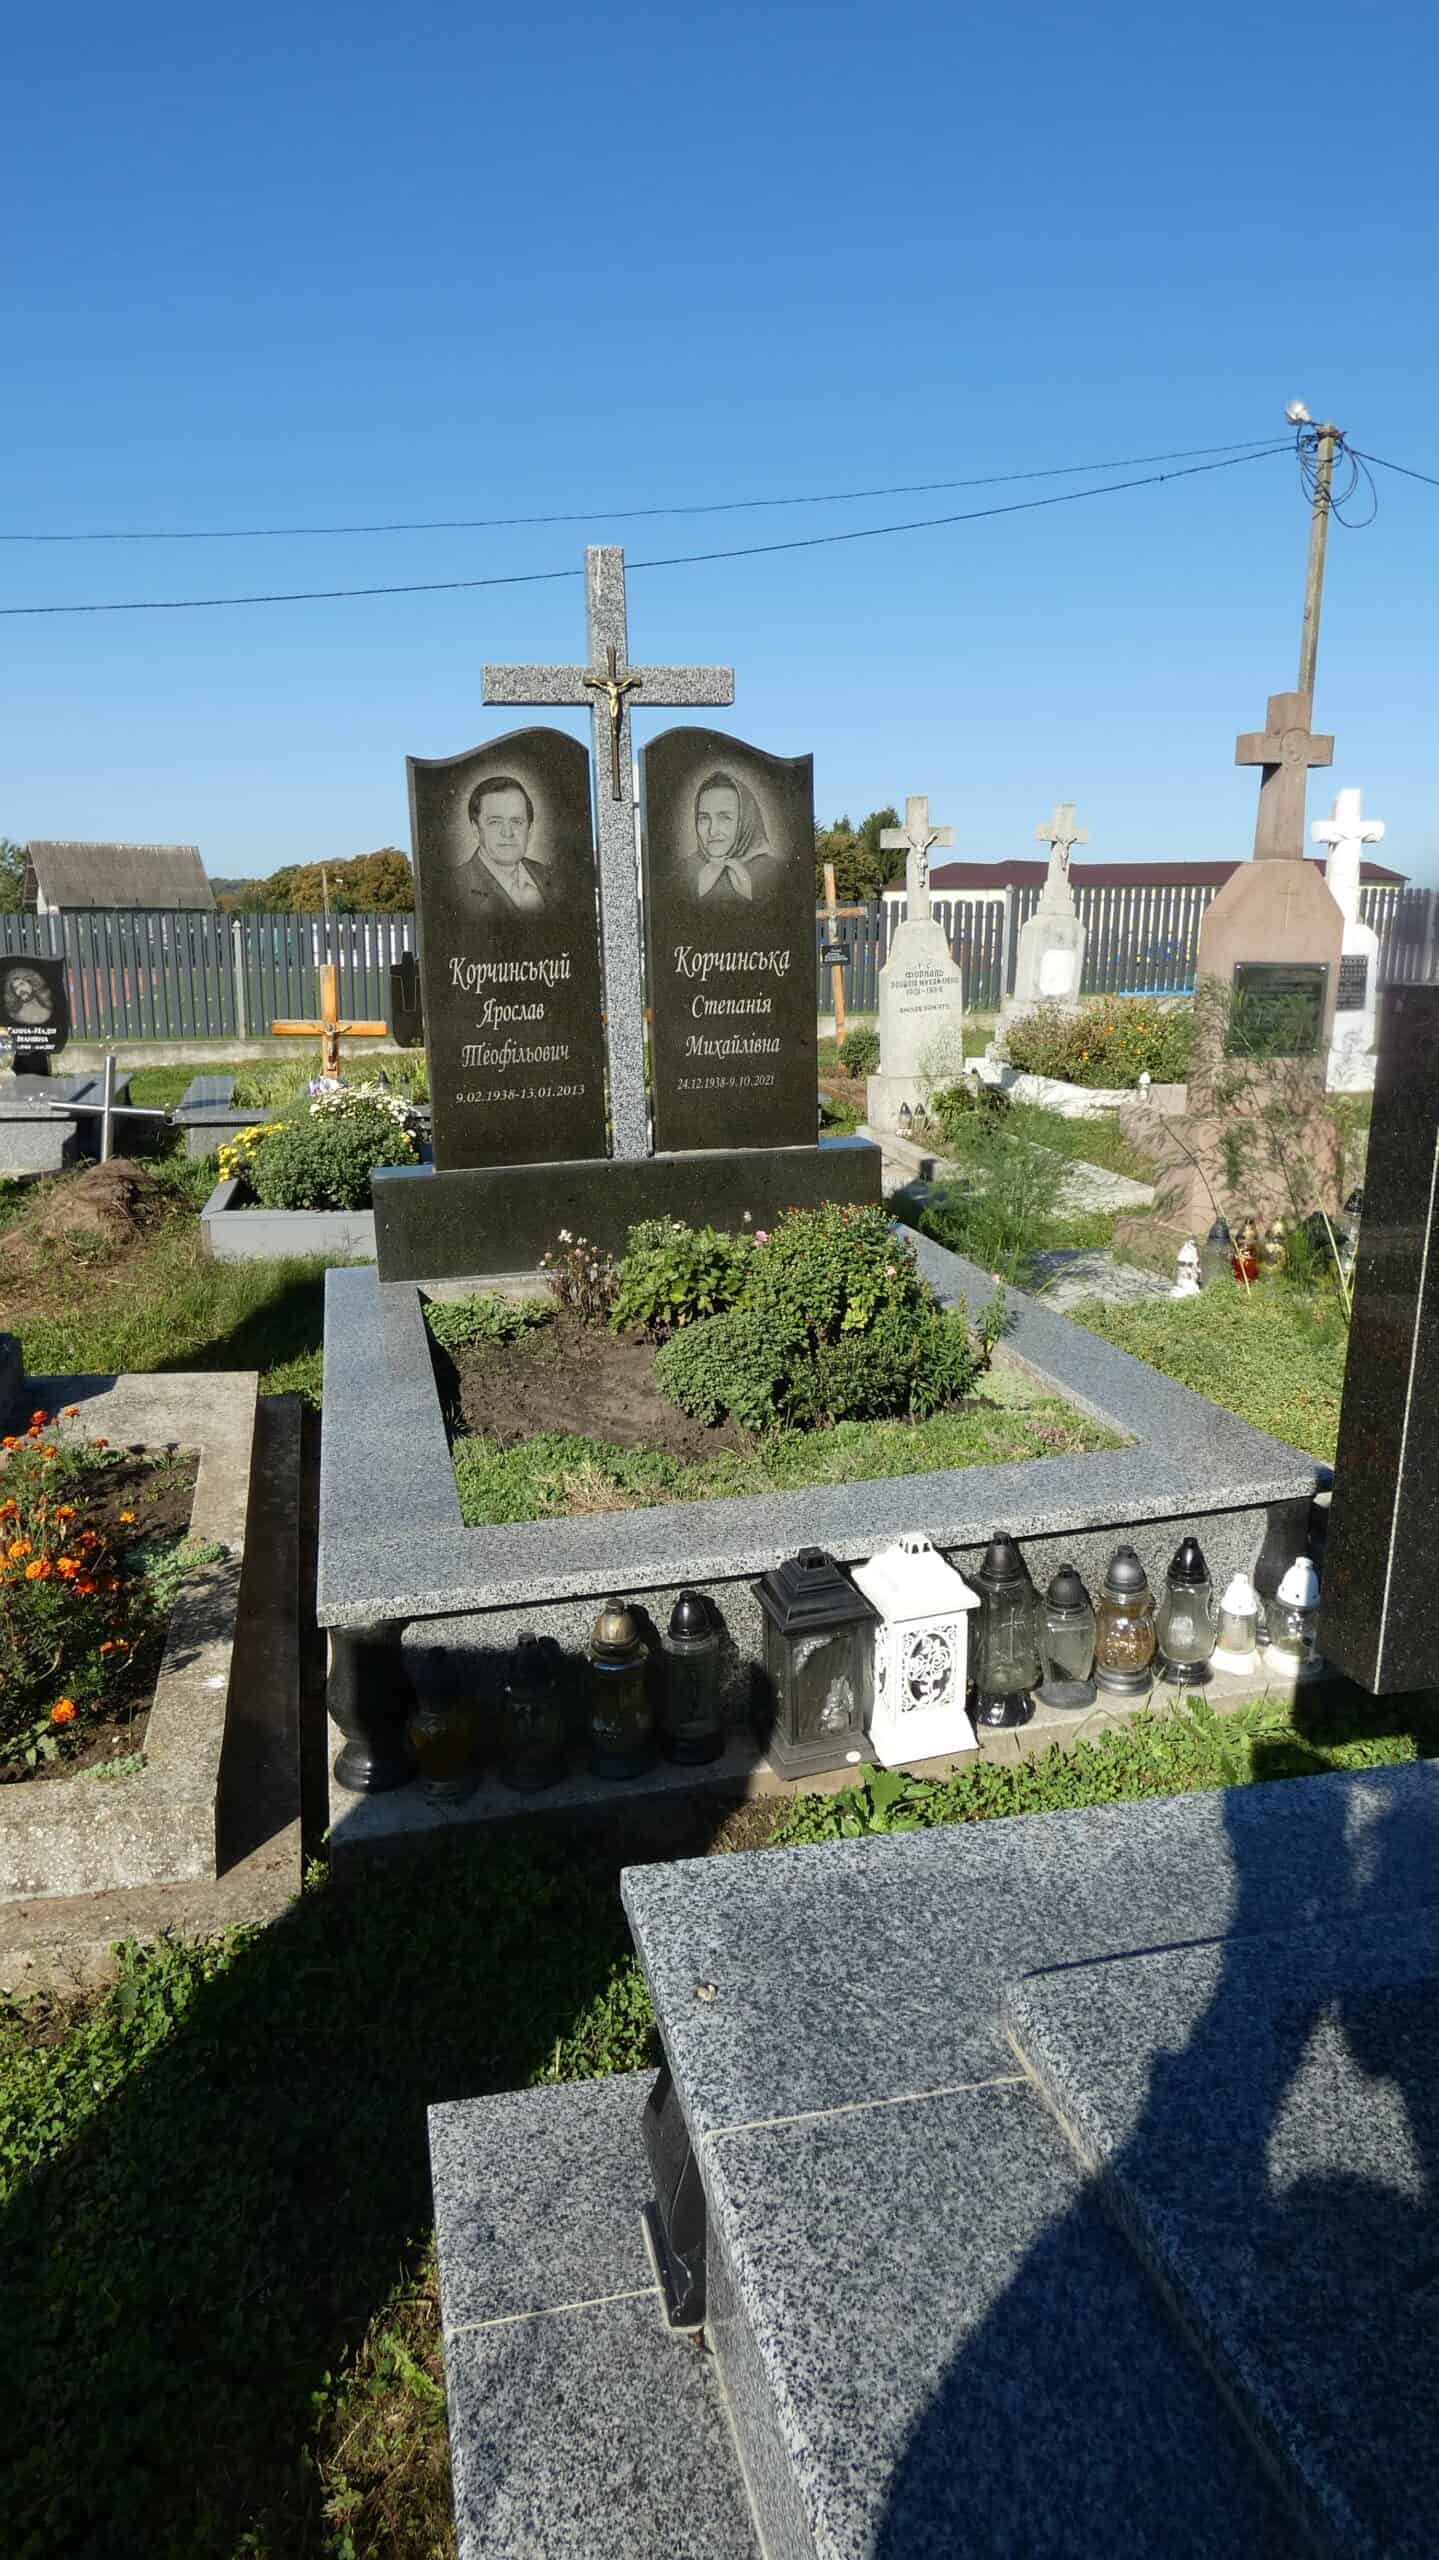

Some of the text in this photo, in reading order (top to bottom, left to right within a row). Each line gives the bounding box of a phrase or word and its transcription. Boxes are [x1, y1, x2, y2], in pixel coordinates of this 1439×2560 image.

[448, 951, 572, 994] Корчинський
[673, 946, 791, 981] Корчинська
[475, 998, 545, 1030] Ярослав
[691, 991, 773, 1018] Степанія
[461, 1038, 570, 1073] Теофільович
[685, 1032, 781, 1059] Михайлівна
